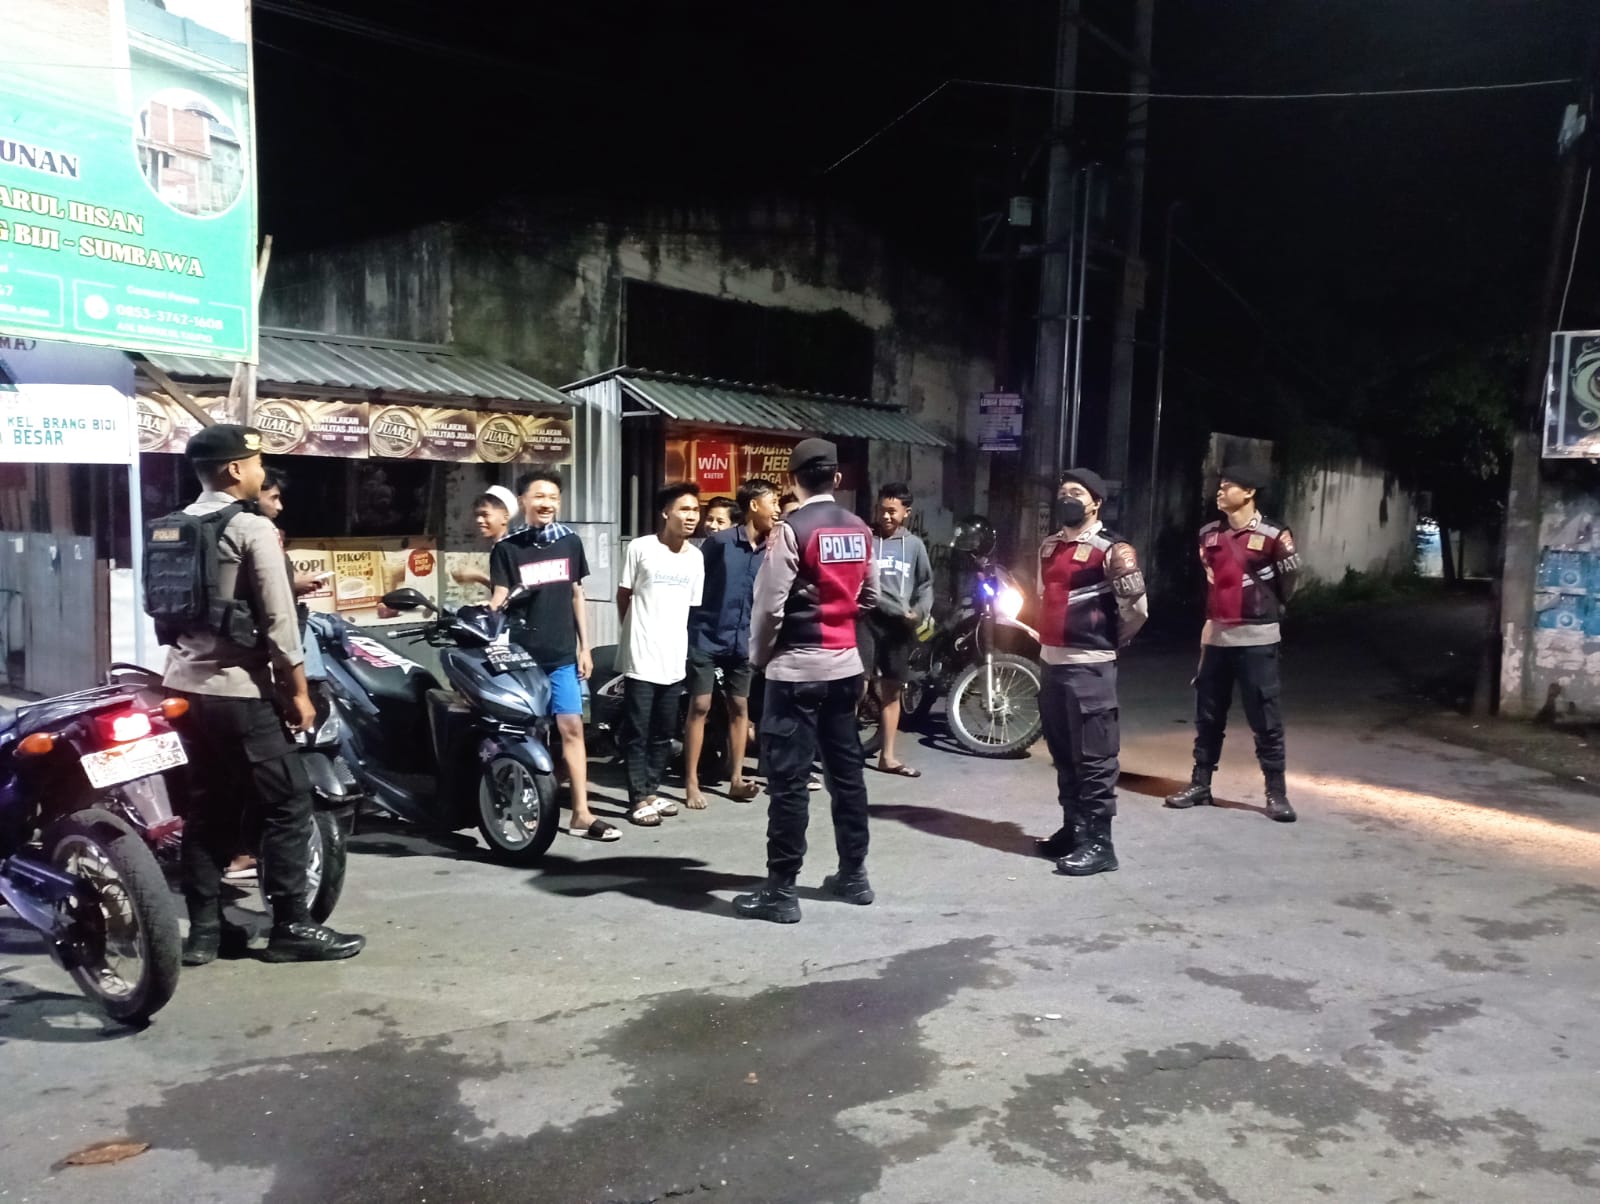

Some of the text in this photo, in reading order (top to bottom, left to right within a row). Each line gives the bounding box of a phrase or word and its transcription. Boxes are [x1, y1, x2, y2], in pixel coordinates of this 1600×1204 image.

[68, 200, 144, 235] IHSAN
[79, 235, 205, 277] SUMBAWA
[7, 416, 116, 431] KEL BRANG BIJI
[257, 415, 296, 433] JUARA
[376, 421, 413, 440] JUARA
[13, 429, 64, 446] BESAR
[484, 430, 515, 445] JUARA
